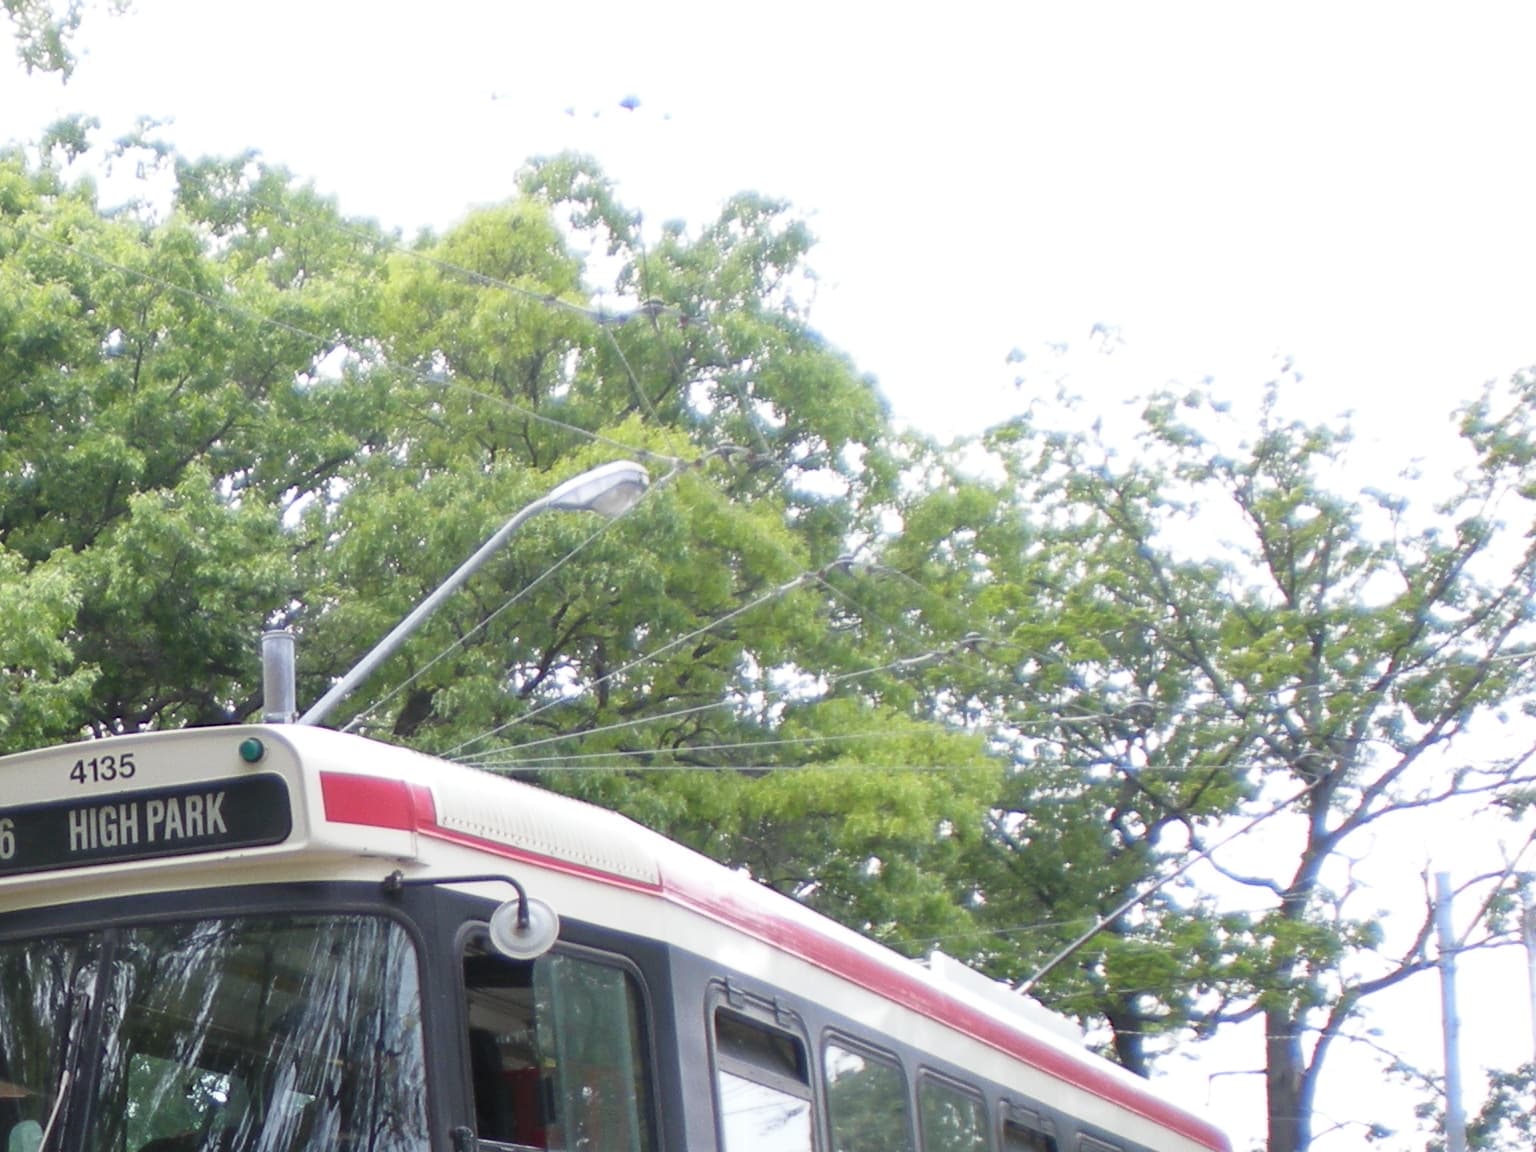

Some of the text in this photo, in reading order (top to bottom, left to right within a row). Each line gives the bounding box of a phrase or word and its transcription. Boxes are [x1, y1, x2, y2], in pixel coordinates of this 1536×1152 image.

[69, 753, 136, 784] 4135
[68, 802, 139, 851] HIGH
[146, 791, 228, 843] PARK
